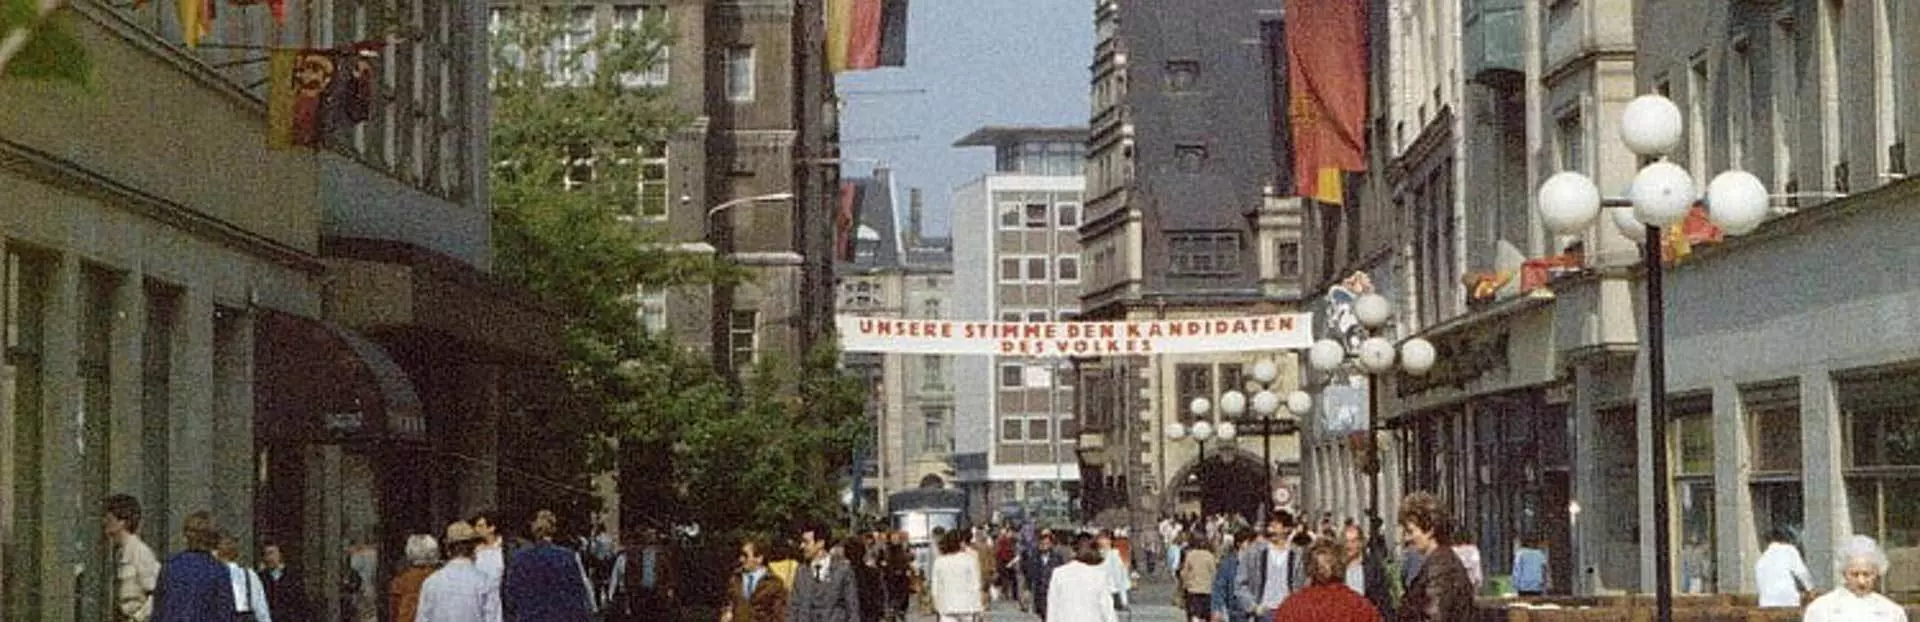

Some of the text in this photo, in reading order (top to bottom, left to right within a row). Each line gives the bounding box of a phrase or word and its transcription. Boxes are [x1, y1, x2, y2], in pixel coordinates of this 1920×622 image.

[859, 316, 1294, 338] UNSERE STIMME DEN KANDIDATEN
[1000, 339, 1152, 353] DES VOLKES
